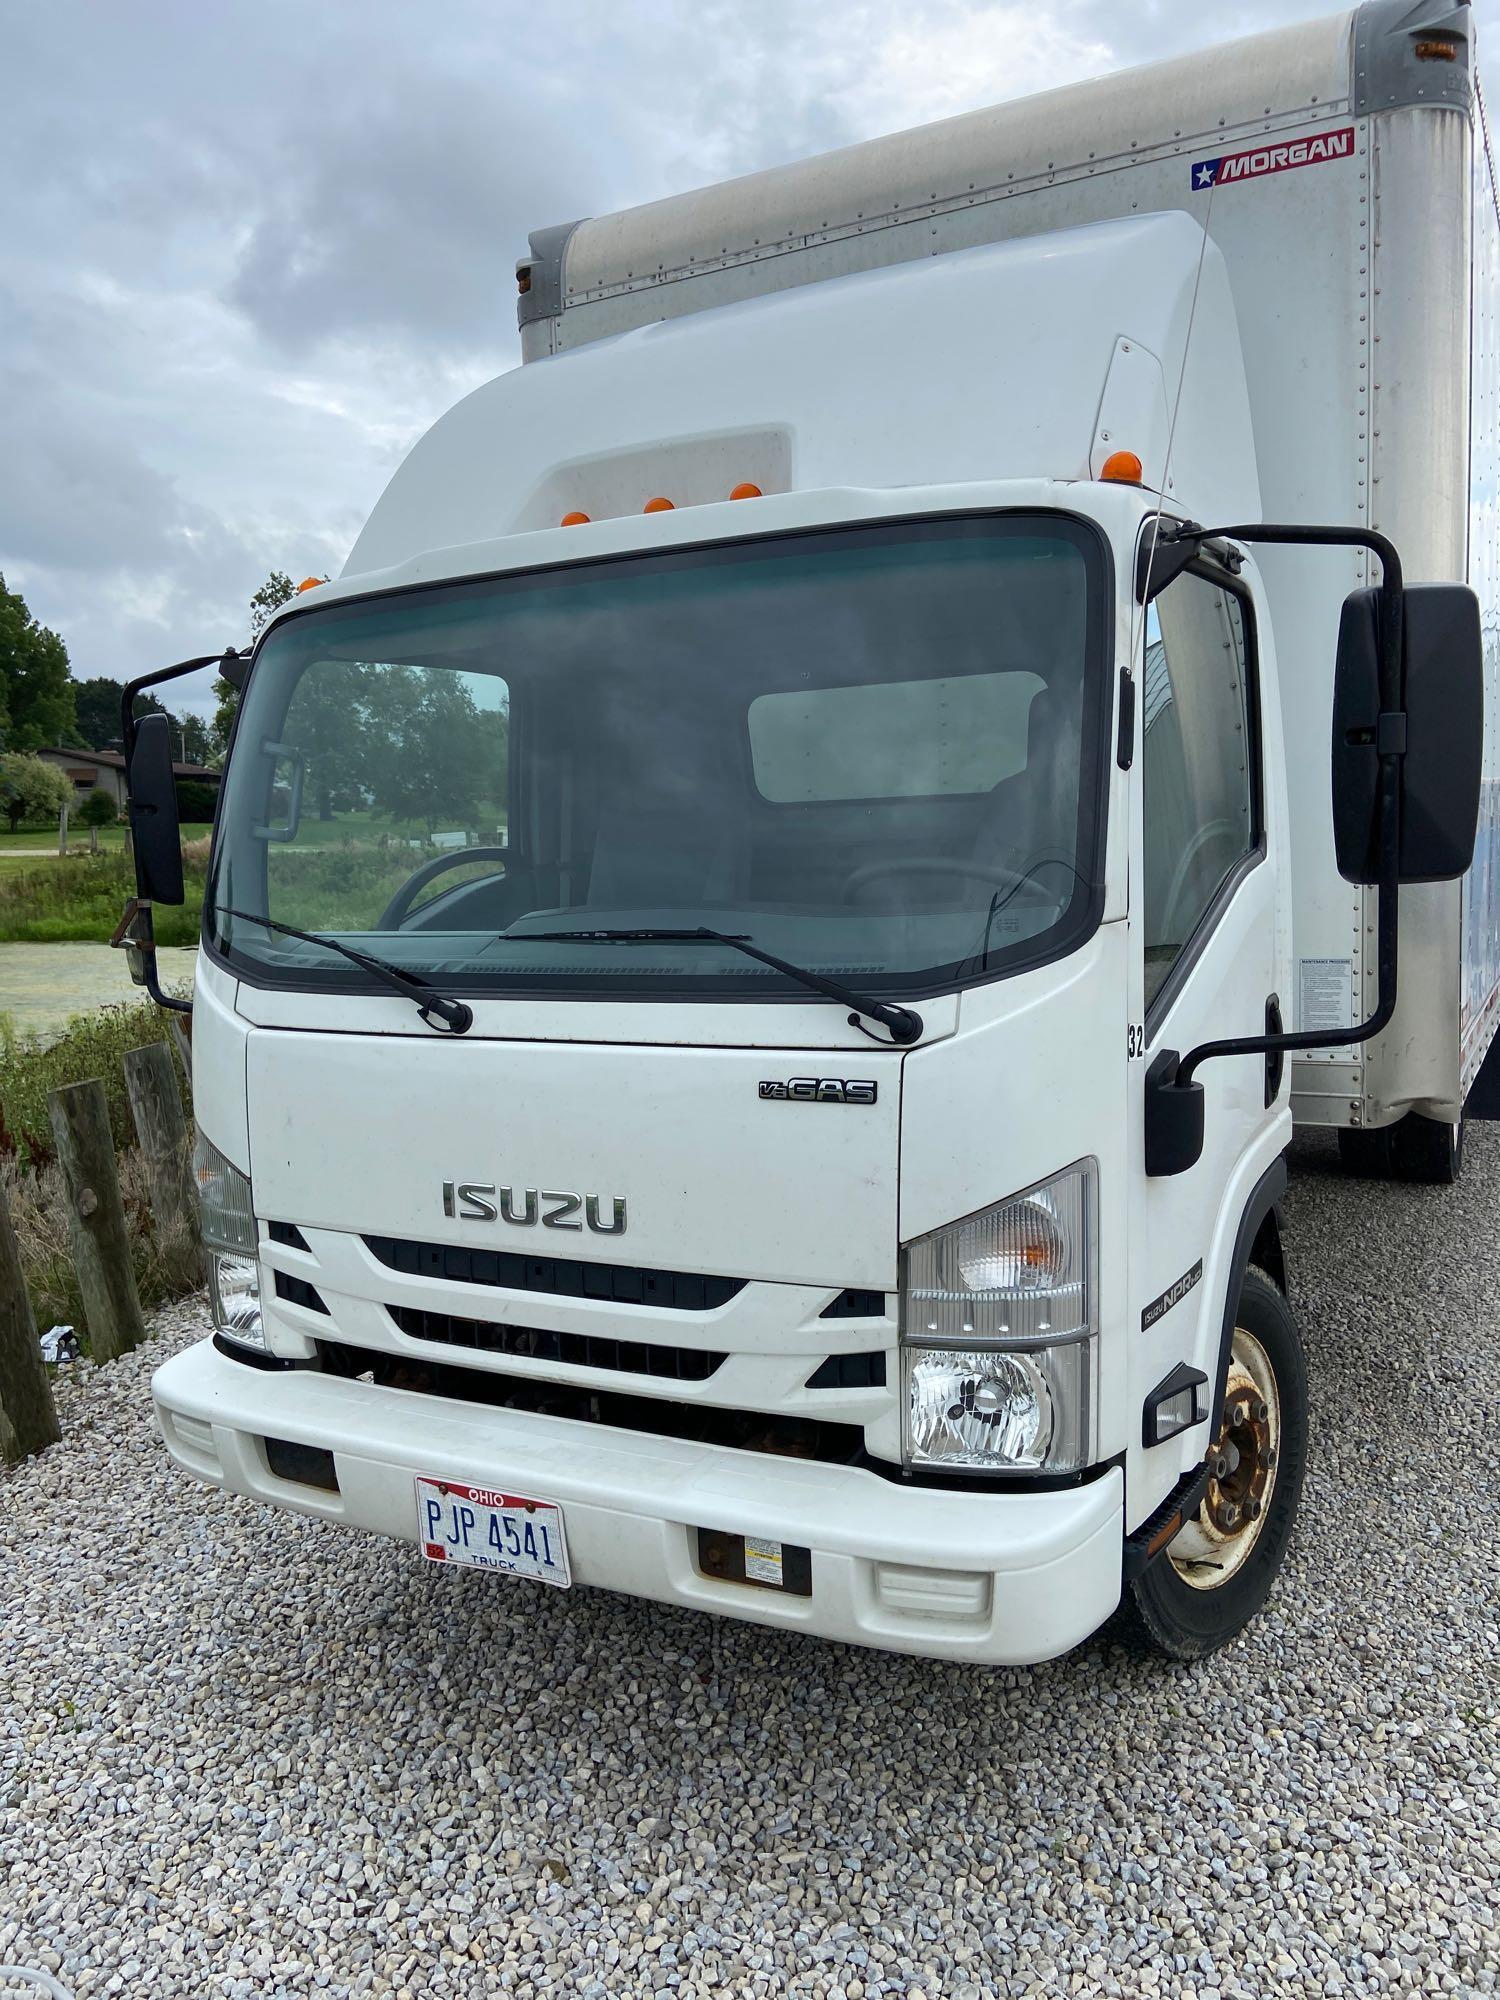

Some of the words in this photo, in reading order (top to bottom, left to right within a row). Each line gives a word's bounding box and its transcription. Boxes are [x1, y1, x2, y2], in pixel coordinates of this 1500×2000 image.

[1221, 133, 1349, 180] MORGAN
[1129, 1025, 1143, 1058] 32
[787, 1078, 877, 1104] GAS
[443, 1179, 627, 1236] ISUZU
[1144, 1302, 1163, 1325] ISUZU
[1163, 1273, 1191, 1312] NPR
[468, 1488, 504, 1507] OHIO
[427, 1499, 475, 1547] PJP
[488, 1513, 555, 1567] 4541
[471, 1554, 516, 1571] TRUCK
